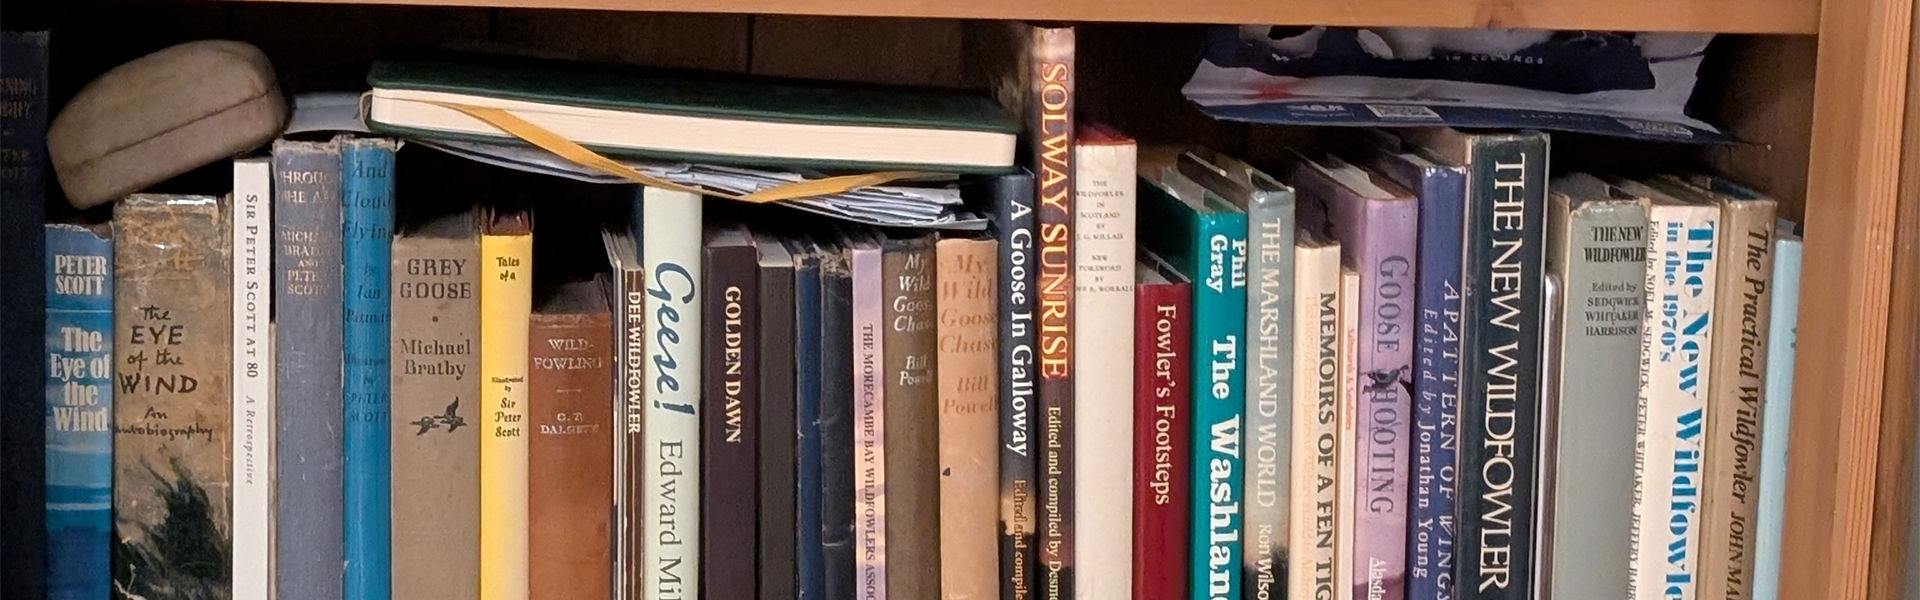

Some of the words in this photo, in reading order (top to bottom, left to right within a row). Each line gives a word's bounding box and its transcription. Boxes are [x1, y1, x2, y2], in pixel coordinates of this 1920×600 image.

[1041, 63, 1068, 215] SOLWAY
[352, 160, 388, 179] And
[246, 194, 258, 219] SIR
[1492, 152, 1526, 231] THE
[1011, 200, 1032, 221] A
[1261, 217, 1280, 263] THE
[1591, 226, 1617, 242] THE
[1619, 226, 1644, 241] NEW
[1647, 220, 1659, 254] Edited
[1667, 221, 1683, 242] in
[55, 254, 107, 276] PETER
[246, 224, 258, 275] PETER
[496, 256, 520, 268] Tales
[904, 253, 929, 275] My
[955, 254, 987, 273] My
[1010, 228, 1032, 305] Goose
[1206, 234, 1228, 294] Gray
[1231, 238, 1247, 289] Phil
[1584, 247, 1647, 262] WILDFOWLER
[1646, 257, 1657, 270] by
[1684, 220, 1714, 298] The
[1747, 229, 1769, 271] The
[407, 258, 467, 276] GREY
[499, 270, 508, 282] of
[510, 273, 516, 281] a
[899, 275, 931, 291] Wild
[1490, 237, 1523, 331] NEW
[1664, 251, 1681, 286] the
[55, 275, 105, 296] SCOTT
[400, 282, 472, 299] GOOSE
[942, 276, 993, 300] Wild
[1041, 223, 1068, 379] SUNRISE
[1443, 279, 1460, 301] A
[1592, 282, 1624, 292] Edited
[1626, 282, 1638, 293] by
[139, 305, 172, 321] The
[246, 280, 258, 333] SCOTT
[628, 291, 641, 322] DEE
[893, 295, 930, 313] Goos
[1376, 255, 1410, 353] GOOSE
[61, 327, 103, 353] The
[130, 325, 184, 345] EYE
[647, 262, 695, 415] Geese!
[725, 286, 741, 375] GOLDEN
[862, 323, 874, 351] THE
[894, 315, 931, 332] Chas
[1011, 311, 1032, 338] In
[1660, 294, 1679, 362] 1970's
[1739, 276, 1766, 379] Practical
[127, 350, 148, 371] of
[155, 349, 185, 366] the
[246, 337, 256, 358] AT
[400, 338, 471, 355] Michael
[1156, 304, 1177, 398] Fowler's
[1258, 268, 1279, 418] MARSHLAND
[1318, 291, 1336, 425] MEMOIRS
[1423, 308, 1438, 381] Edited
[1679, 309, 1710, 399] New
[50, 353, 86, 382] Eye
[90, 353, 110, 379] of
[118, 373, 199, 395] WIND
[246, 362, 259, 378] 80
[405, 359, 467, 381] Bratby
[628, 326, 641, 434] WILDFOWLER
[1212, 335, 1236, 400] The
[1440, 308, 1460, 450] PATTERN
[64, 381, 99, 406] the
[246, 395, 255, 404] A
[500, 397, 516, 408] Sir
[862, 354, 875, 437] MORECAMBE
[1006, 344, 1033, 456] Galloway
[1419, 390, 1437, 414] by
[52, 406, 109, 432] Wind
[144, 406, 168, 422] An
[494, 411, 522, 422] Peter
[725, 381, 741, 443] DAWN
[1048, 406, 1061, 448] Edited
[1637, 397, 1647, 435] PETER
[243, 409, 256, 485] Retrospective
[495, 426, 521, 437] Scott
[1370, 378, 1399, 514] HOOTING
[1730, 386, 1758, 504] Wildfowler
[863, 440, 875, 464] BAY
[1048, 450, 1061, 475] and
[1150, 404, 1175, 506] Footsteps
[1257, 424, 1277, 508] WORLD
[1317, 432, 1335, 466] OF
[1418, 420, 1436, 508] Jonathan
[1317, 474, 1333, 493] A
[1439, 465, 1454, 500] OF
[1478, 341, 1519, 594] WILDFOWLER
[659, 440, 682, 546] Edward
[1045, 478, 1061, 537] compiled
[1209, 413, 1240, 600] Washlan
[864, 468, 876, 561] WILDFOWLERS
[1316, 501, 1333, 549] FEN
[1046, 541, 1061, 557] by
[1258, 524, 1272, 555] Ron
[1413, 518, 1434, 578] Young
[1729, 511, 1745, 564] JOHN
[1726, 564, 1742, 600] MA
